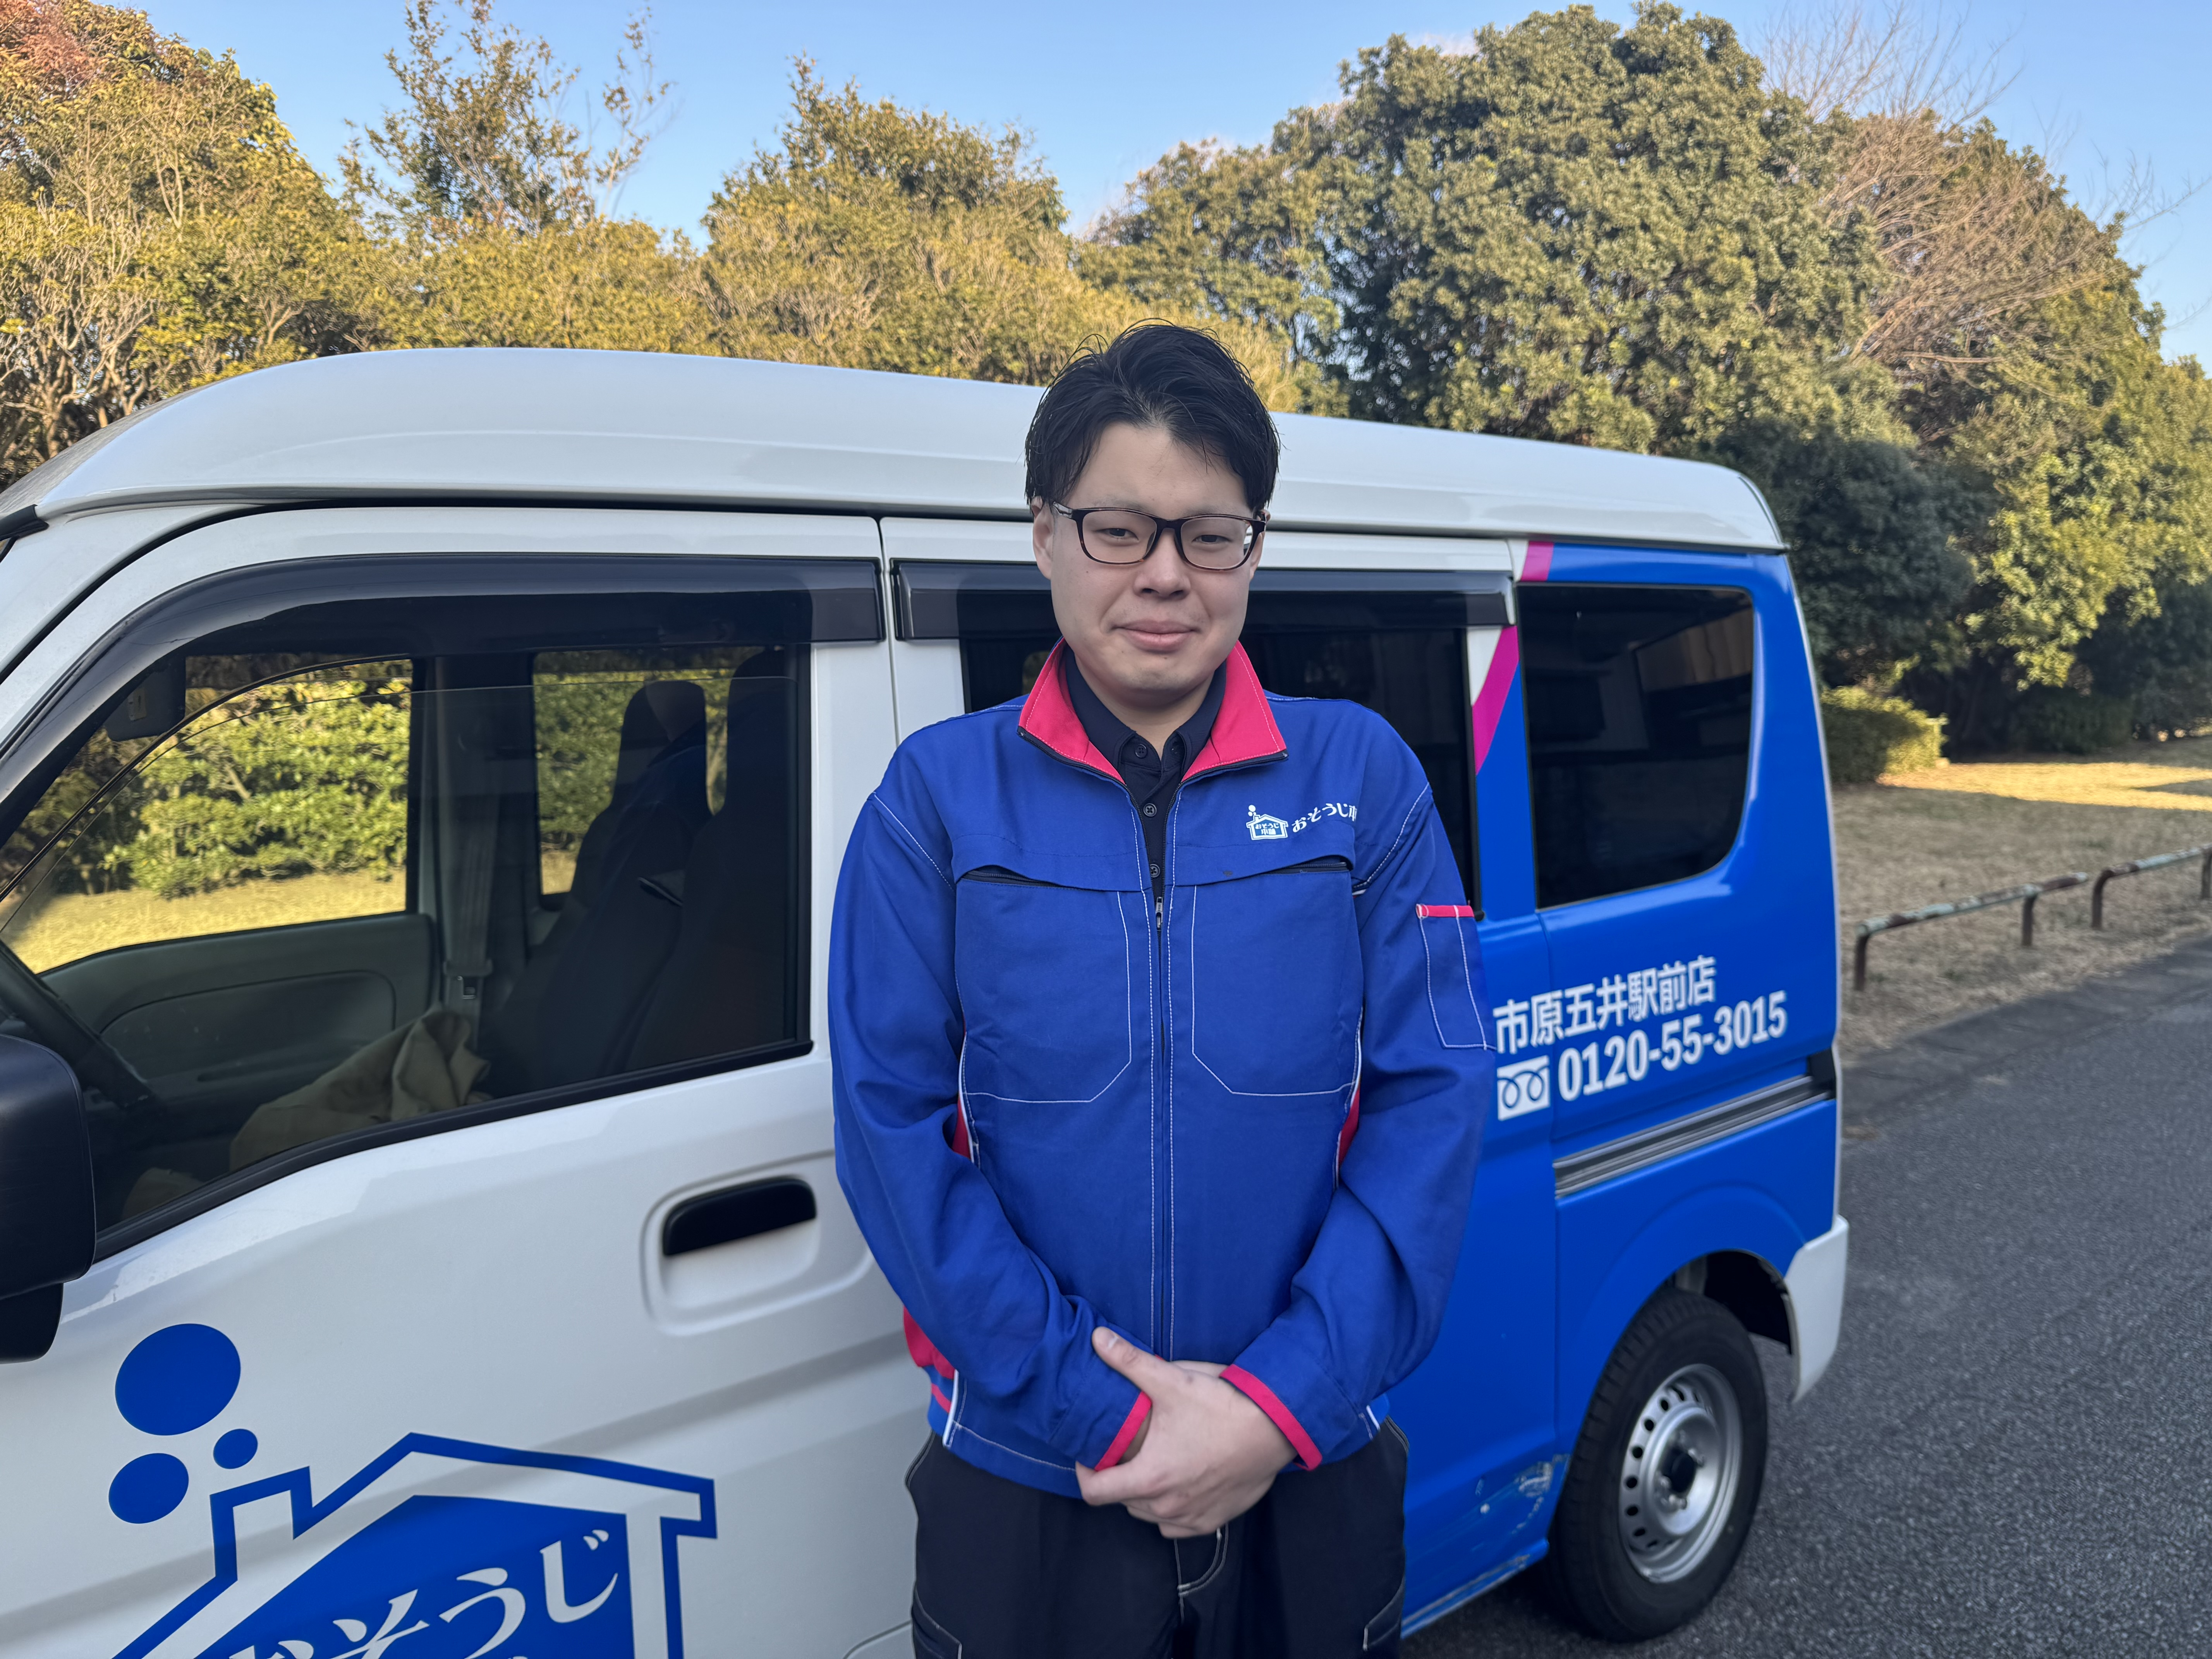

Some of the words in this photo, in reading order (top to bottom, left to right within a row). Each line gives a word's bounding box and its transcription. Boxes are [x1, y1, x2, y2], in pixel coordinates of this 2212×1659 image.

[1492, 955, 1716, 1054] 市原五井駅前店
[1558, 990, 1787, 1101] 0120-55-3015
[229, 1530, 617, 1659] そうじ
